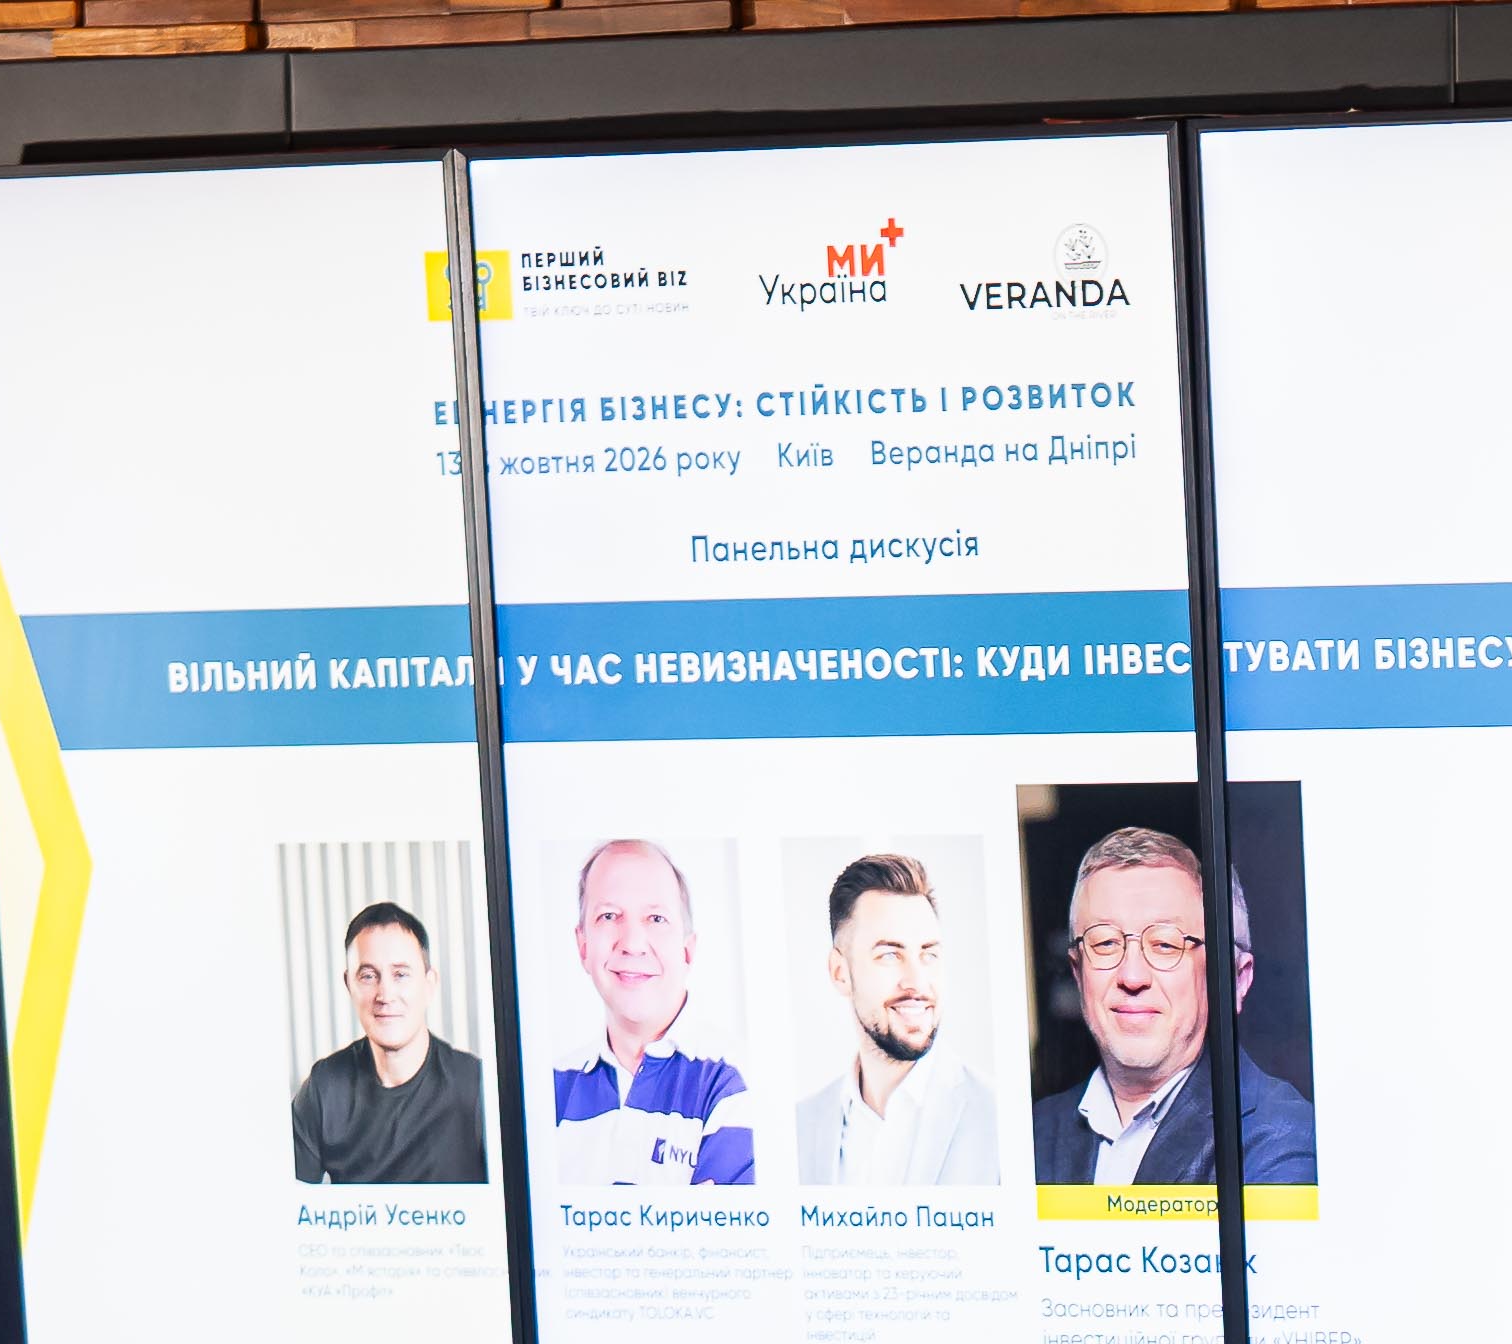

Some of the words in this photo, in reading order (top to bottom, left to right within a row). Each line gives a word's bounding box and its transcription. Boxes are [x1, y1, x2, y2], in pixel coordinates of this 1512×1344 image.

[521, 245, 605, 269] ПЕРШИЙ
[522, 267, 649, 292] БІЗНЕСОВИЙ
[758, 272, 887, 312] Україна
[959, 278, 1132, 311] VERANDA
[599, 392, 744, 422] БІЗНЕСУ:
[755, 383, 928, 418] СТІЙКІСТЬ
[940, 386, 949, 413] І
[960, 381, 1137, 412] РОЗВИТОК
[499, 454, 596, 476] жовтня
[603, 445, 668, 473] 2026
[676, 450, 742, 478] року
[777, 441, 835, 468] Київ
[870, 439, 996, 472] Веранда
[1004, 442, 1039, 463] на
[1047, 432, 1136, 467] Дніпрі
[690, 534, 840, 564] Панельна
[849, 527, 980, 566] дискусія
[167, 652, 317, 694] ВІЛЬНИЙ
[519, 655, 538, 686] У
[550, 653, 623, 685] ЧАС
[635, 647, 964, 684] НЕВИЗНАЧЕНОСТІ:
[977, 645, 1070, 682] КУДИ
[1085, 636, 1361, 678] ІНВЕСТУВАТИ
[296, 1203, 377, 1232] Андрій
[384, 1203, 467, 1227] Усенко
[559, 1203, 633, 1232] Тарас
[639, 1203, 771, 1232] Кириченко
[799, 1204, 909, 1229] Михайло
[915, 1204, 995, 1233] Пацан
[1106, 1193, 1219, 1217] Модератор
[1037, 1244, 1132, 1281] Тарас
[1040, 1297, 1151, 1321] Засновник
[1155, 1303, 1180, 1319] та
